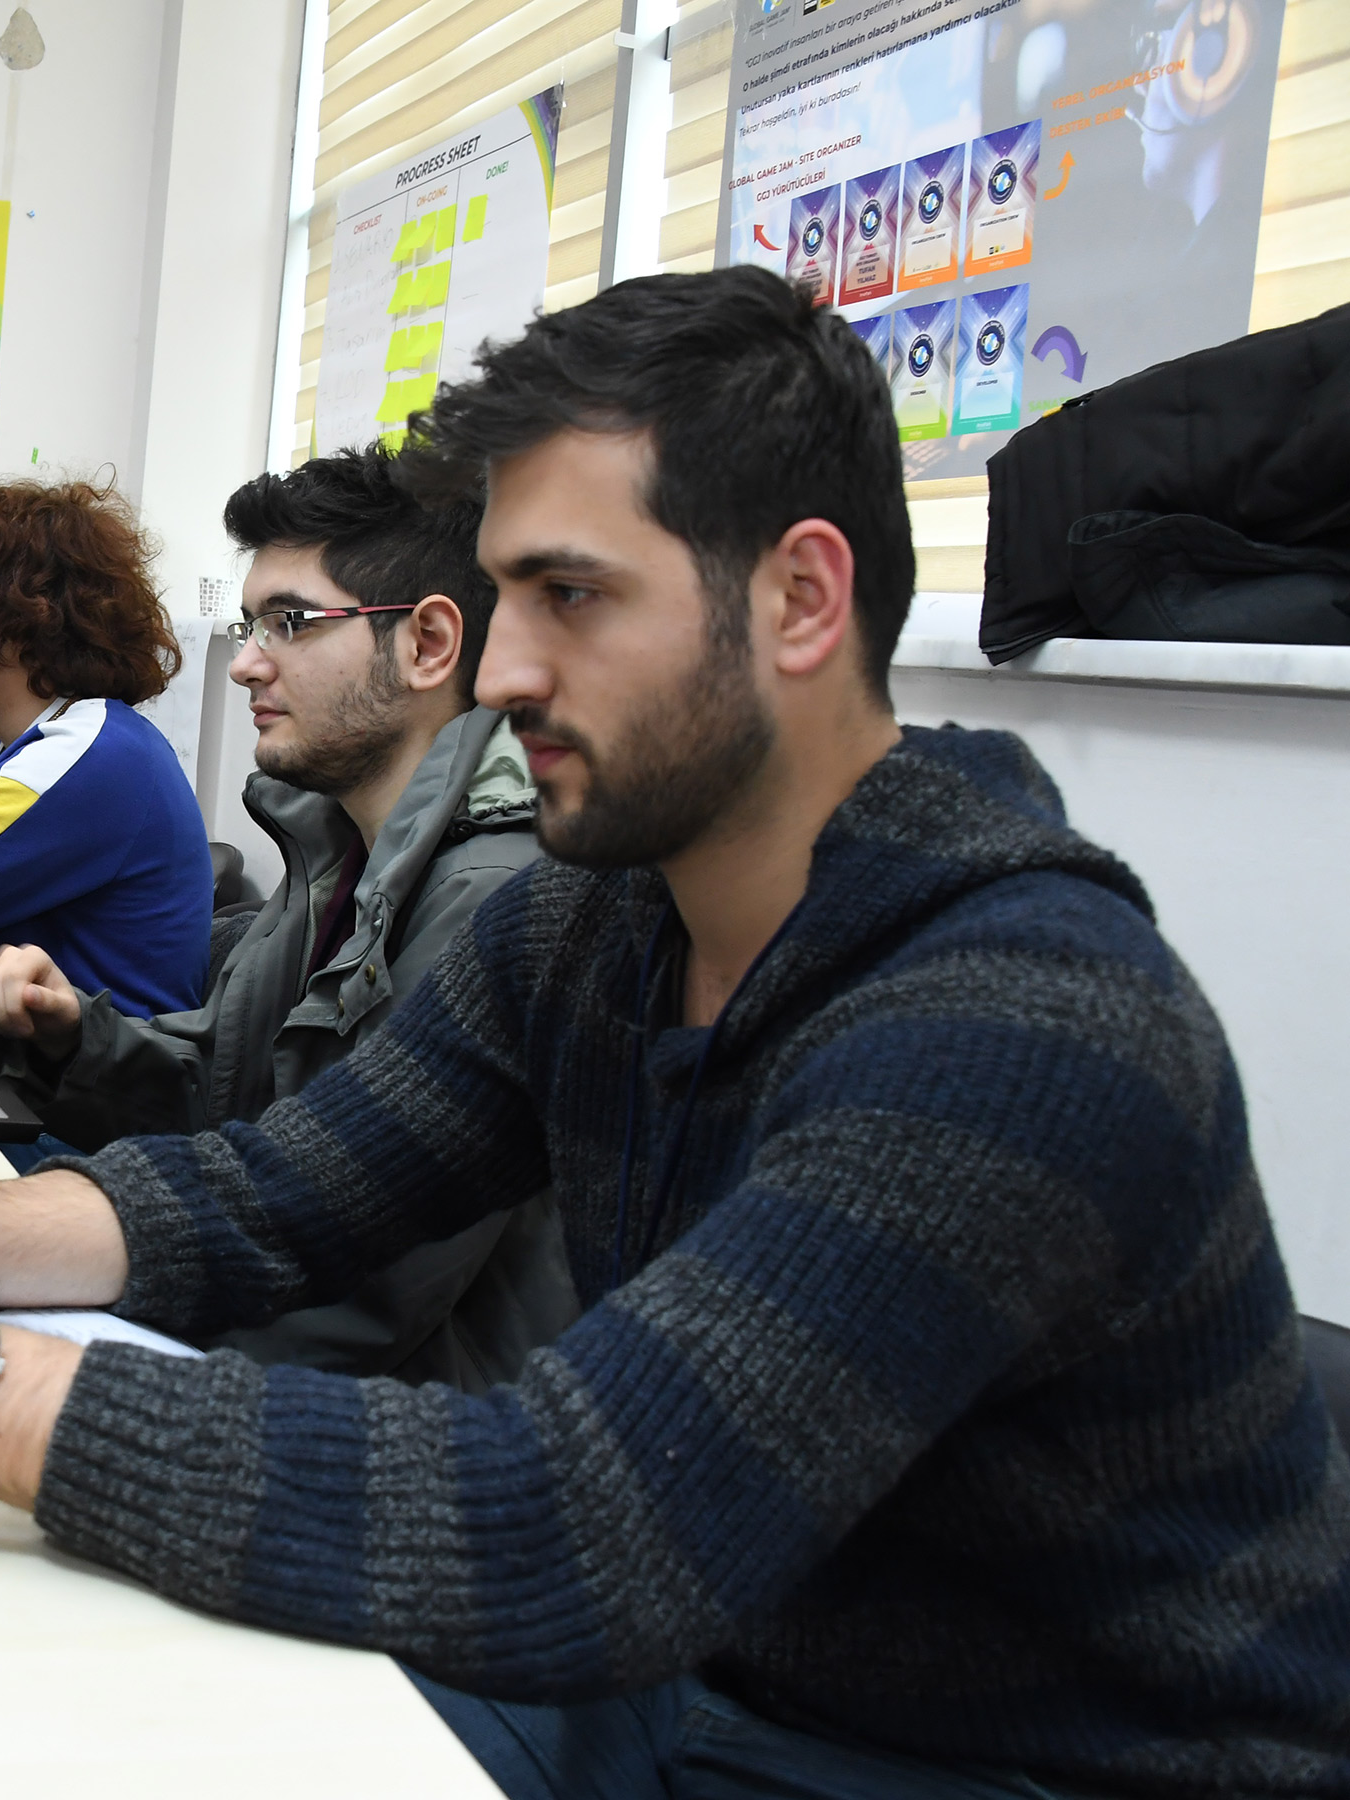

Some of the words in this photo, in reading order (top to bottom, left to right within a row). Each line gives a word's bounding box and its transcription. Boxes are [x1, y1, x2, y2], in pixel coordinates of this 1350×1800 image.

[750, 75, 769, 90] halde
[791, 48, 829, 71] etrafında
[831, 33, 865, 56] kimlerin
[900, 1, 942, 26] hakkında
[777, 85, 796, 101] yaka
[841, 51, 874, 75] renkleri
[876, 32, 928, 60] hatırlamana
[929, 13, 972, 41] yardımcı
[1052, 91, 1086, 110] YEREL
[395, 152, 447, 190] PROGRESS
[447, 134, 481, 165] SHEET
[486, 160, 510, 181] DONE!
[728, 173, 755, 191] GLOBAL
[756, 165, 778, 181] GAME
[778, 159, 794, 174] JAM
[799, 151, 815, 166] SITE
[816, 134, 862, 159] ORGANIZER
[353, 214, 383, 236] CHECKLIST
